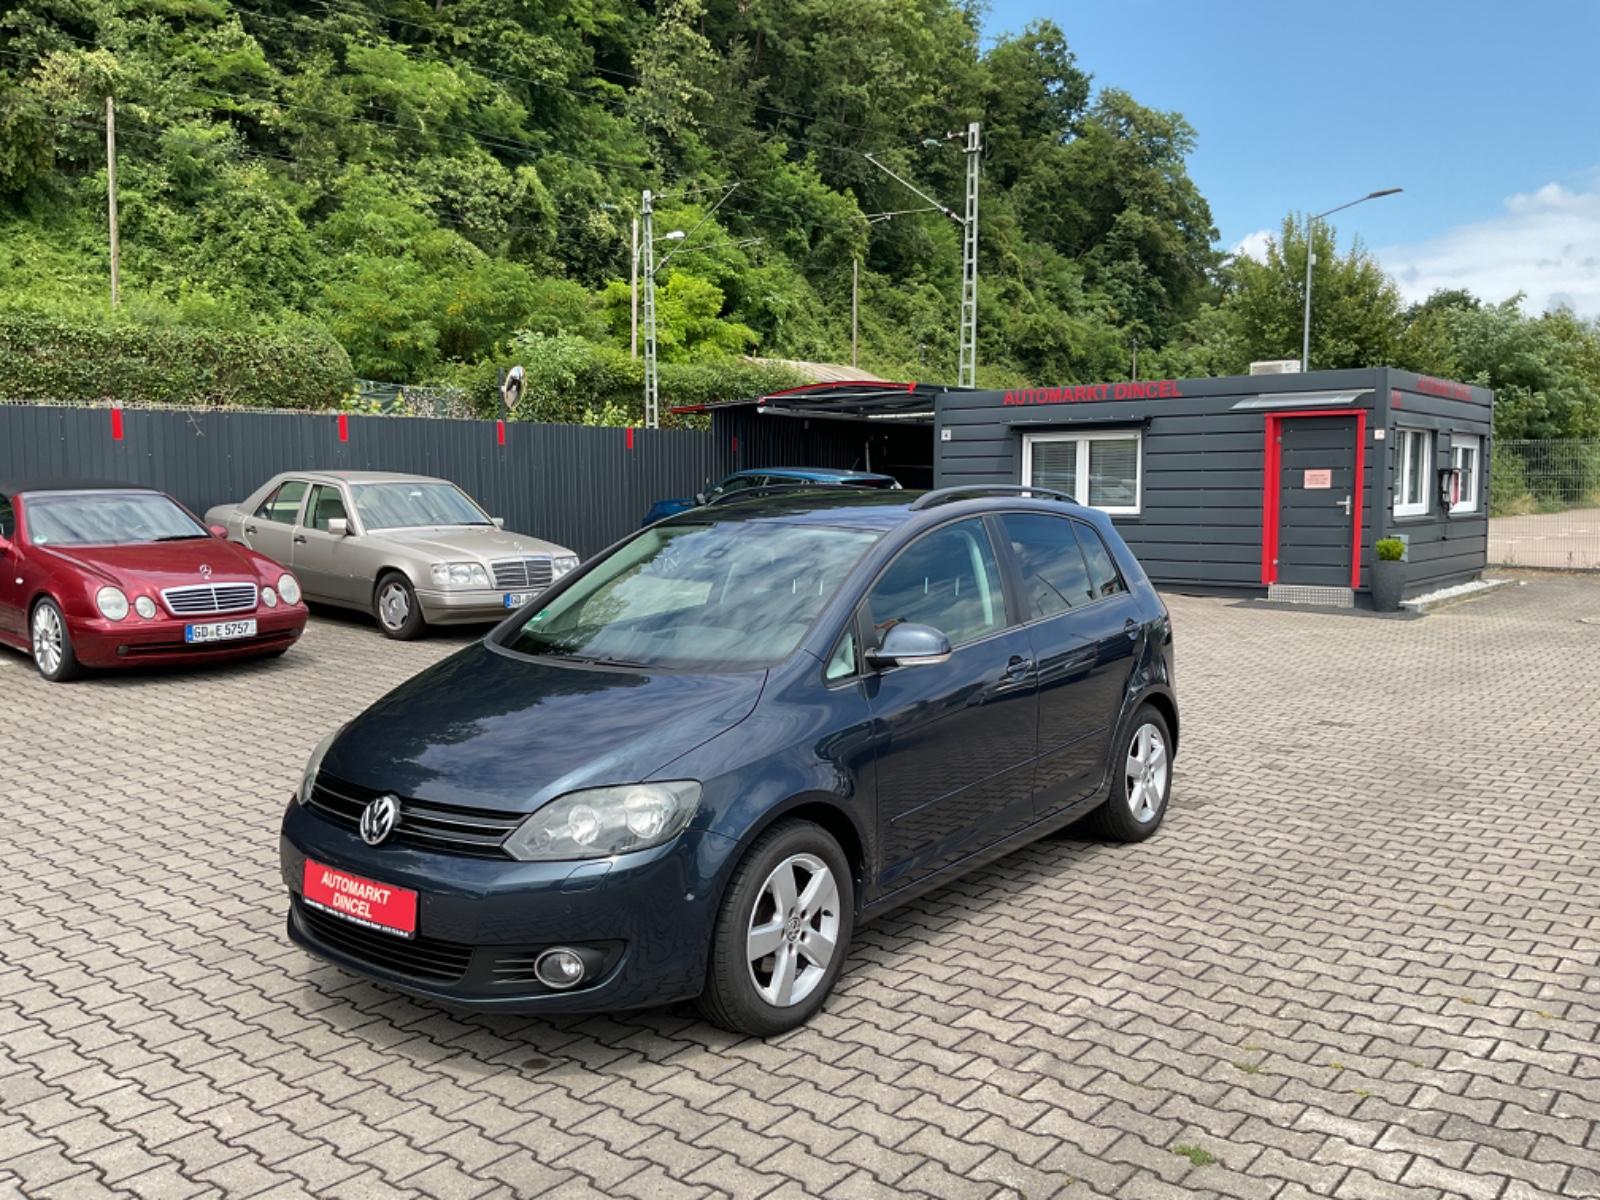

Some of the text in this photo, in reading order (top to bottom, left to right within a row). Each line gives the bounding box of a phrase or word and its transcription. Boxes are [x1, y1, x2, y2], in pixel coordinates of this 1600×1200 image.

[1003, 379, 1184, 405] AUTOMARKT DINCEL
[195, 621, 250, 638] GD E 5757
[321, 871, 391, 905] AUTOMARKT
[332, 892, 372, 918] DINCEL
